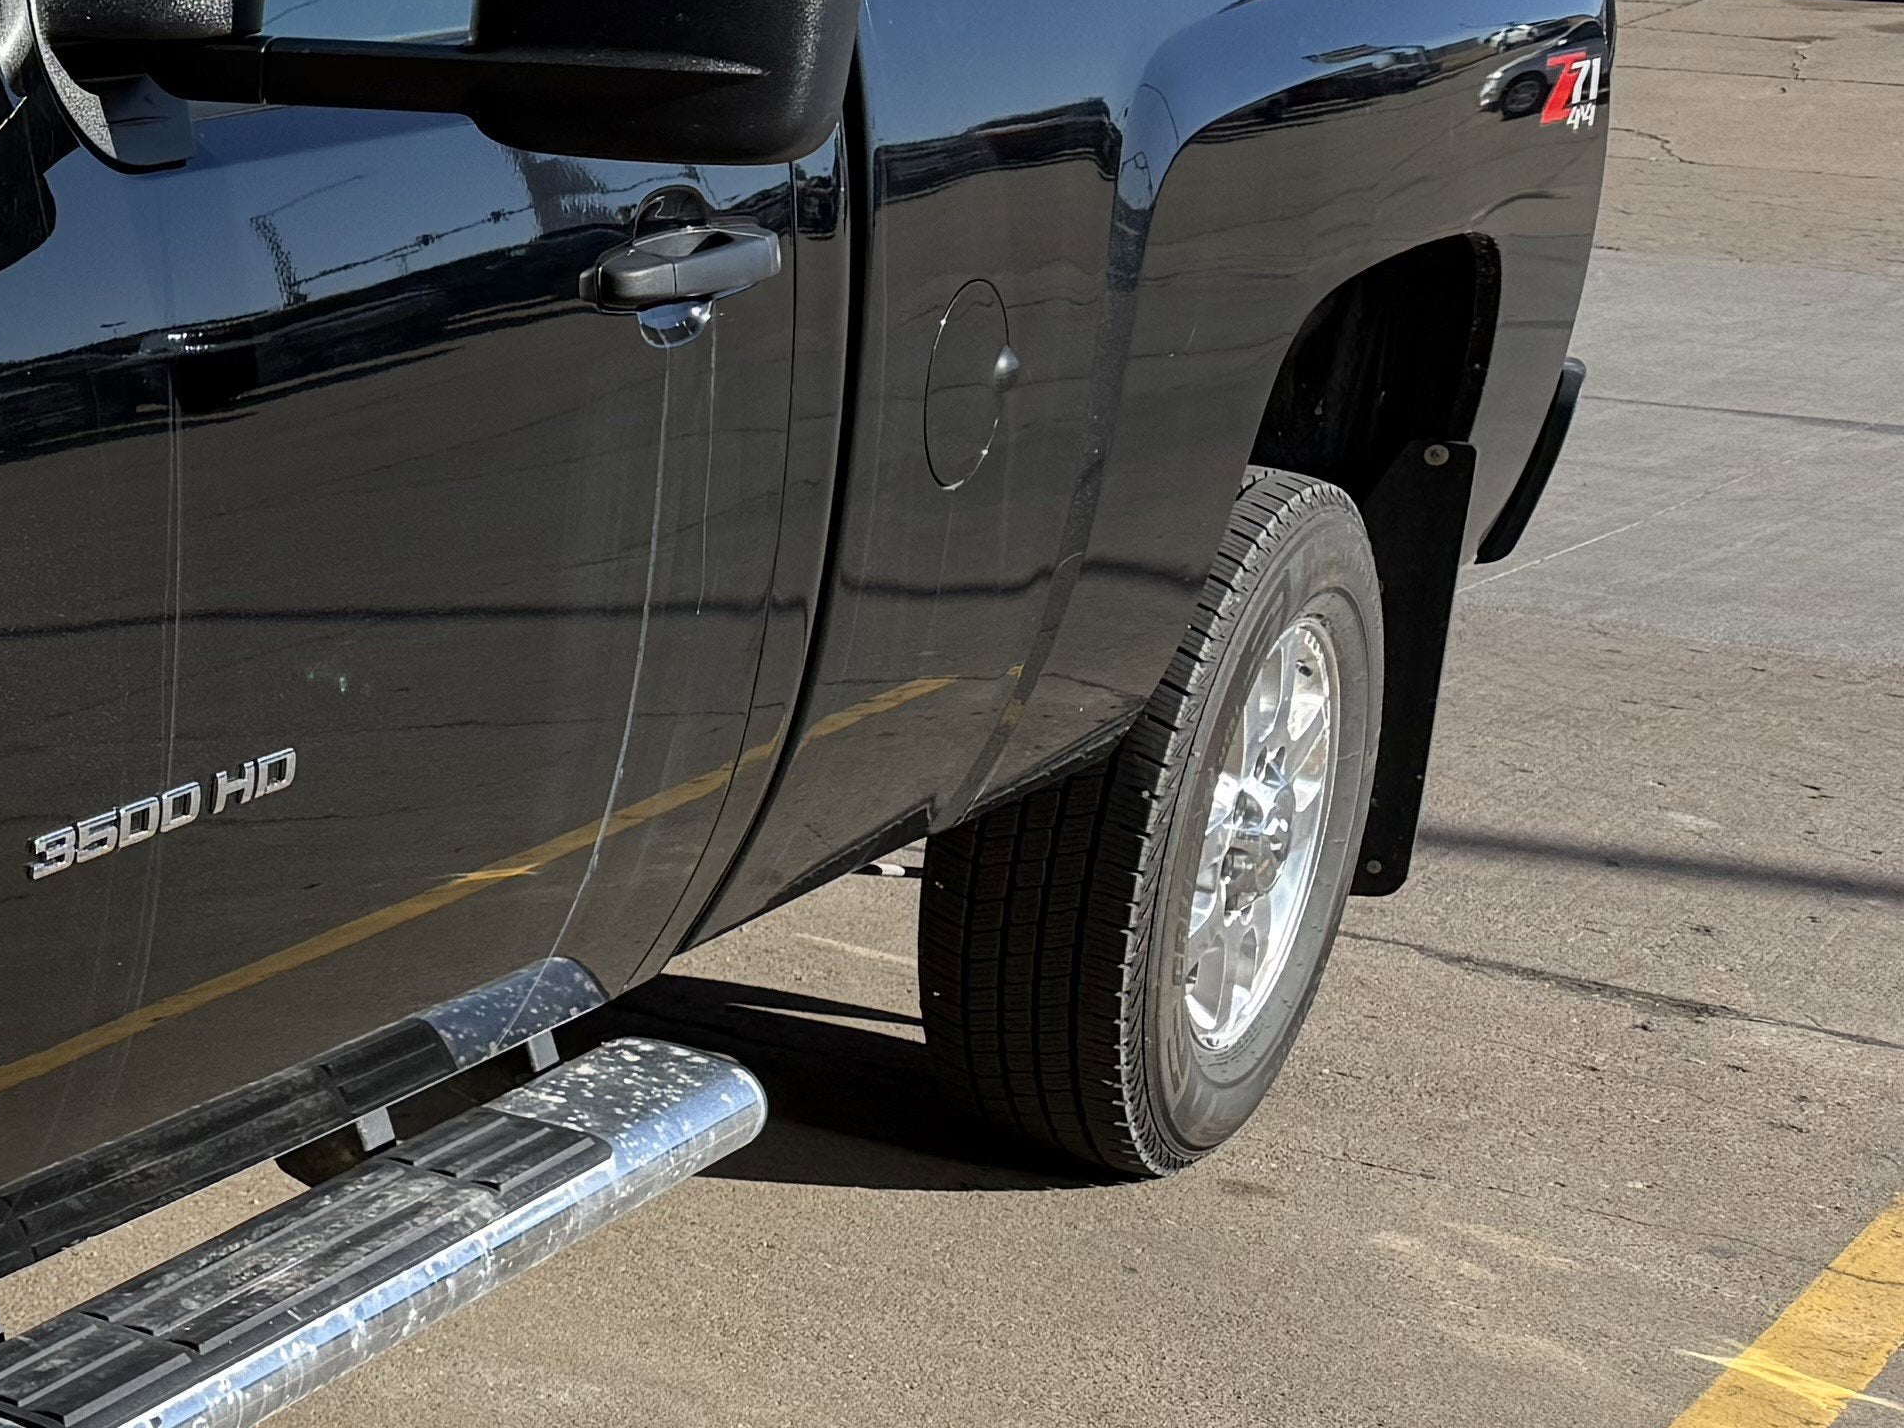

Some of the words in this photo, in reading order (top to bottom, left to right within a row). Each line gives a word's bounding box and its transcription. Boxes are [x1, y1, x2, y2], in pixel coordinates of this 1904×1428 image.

[1541, 51, 1601, 126] Z71
[32, 781, 201, 880] 3500
[211, 747, 297, 815] HD
